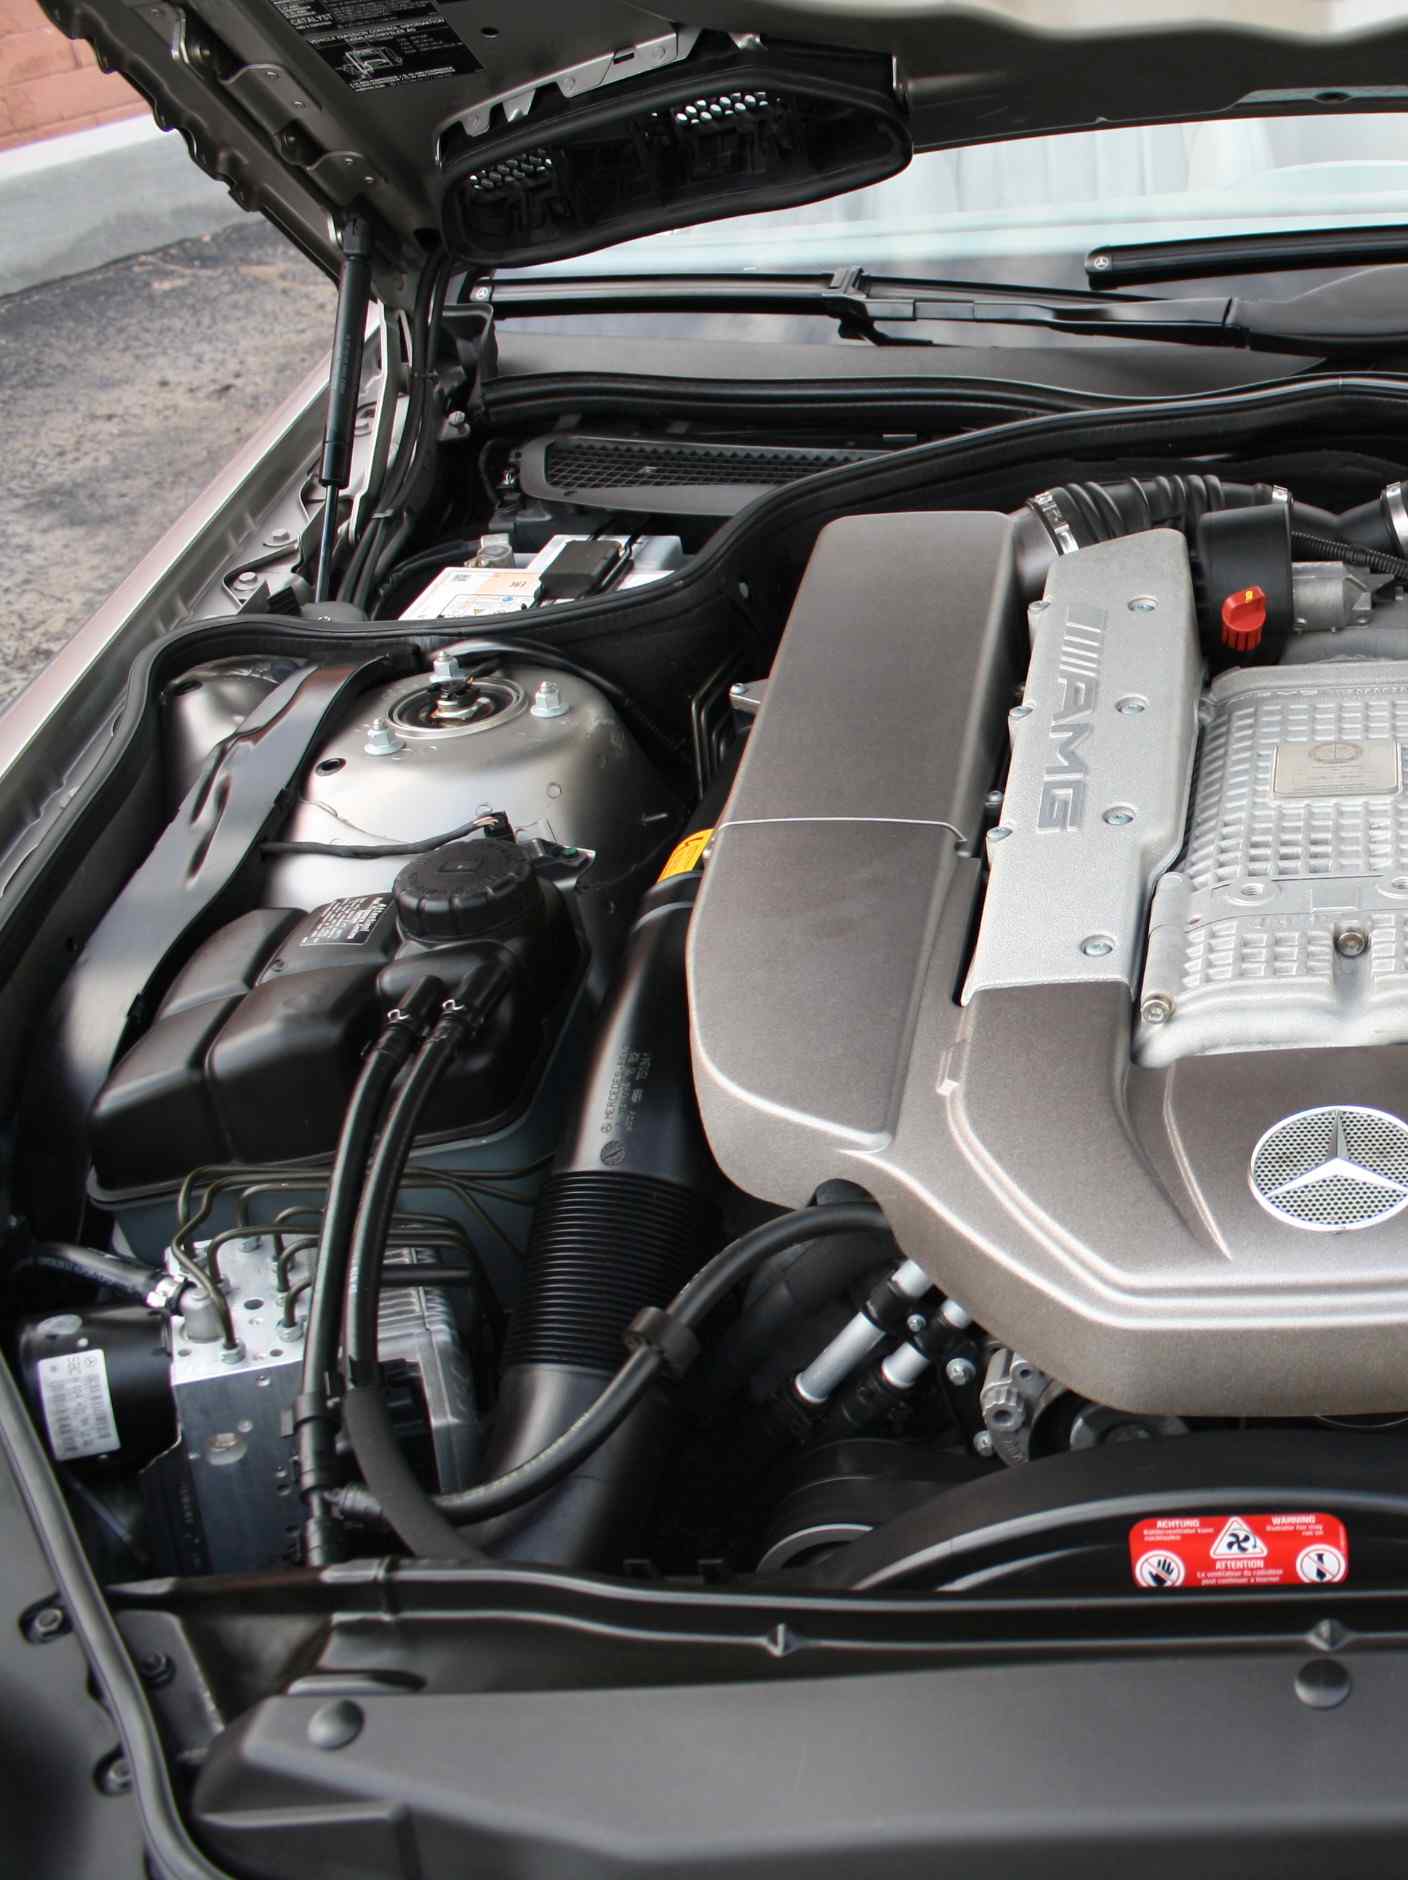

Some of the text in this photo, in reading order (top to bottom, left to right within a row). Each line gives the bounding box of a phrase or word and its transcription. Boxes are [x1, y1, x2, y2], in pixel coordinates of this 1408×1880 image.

[1156, 1519, 1200, 1529] ACHTUNG
[1271, 1514, 1317, 1525] WARNING
[1215, 1559, 1264, 1570] ATTENTION
